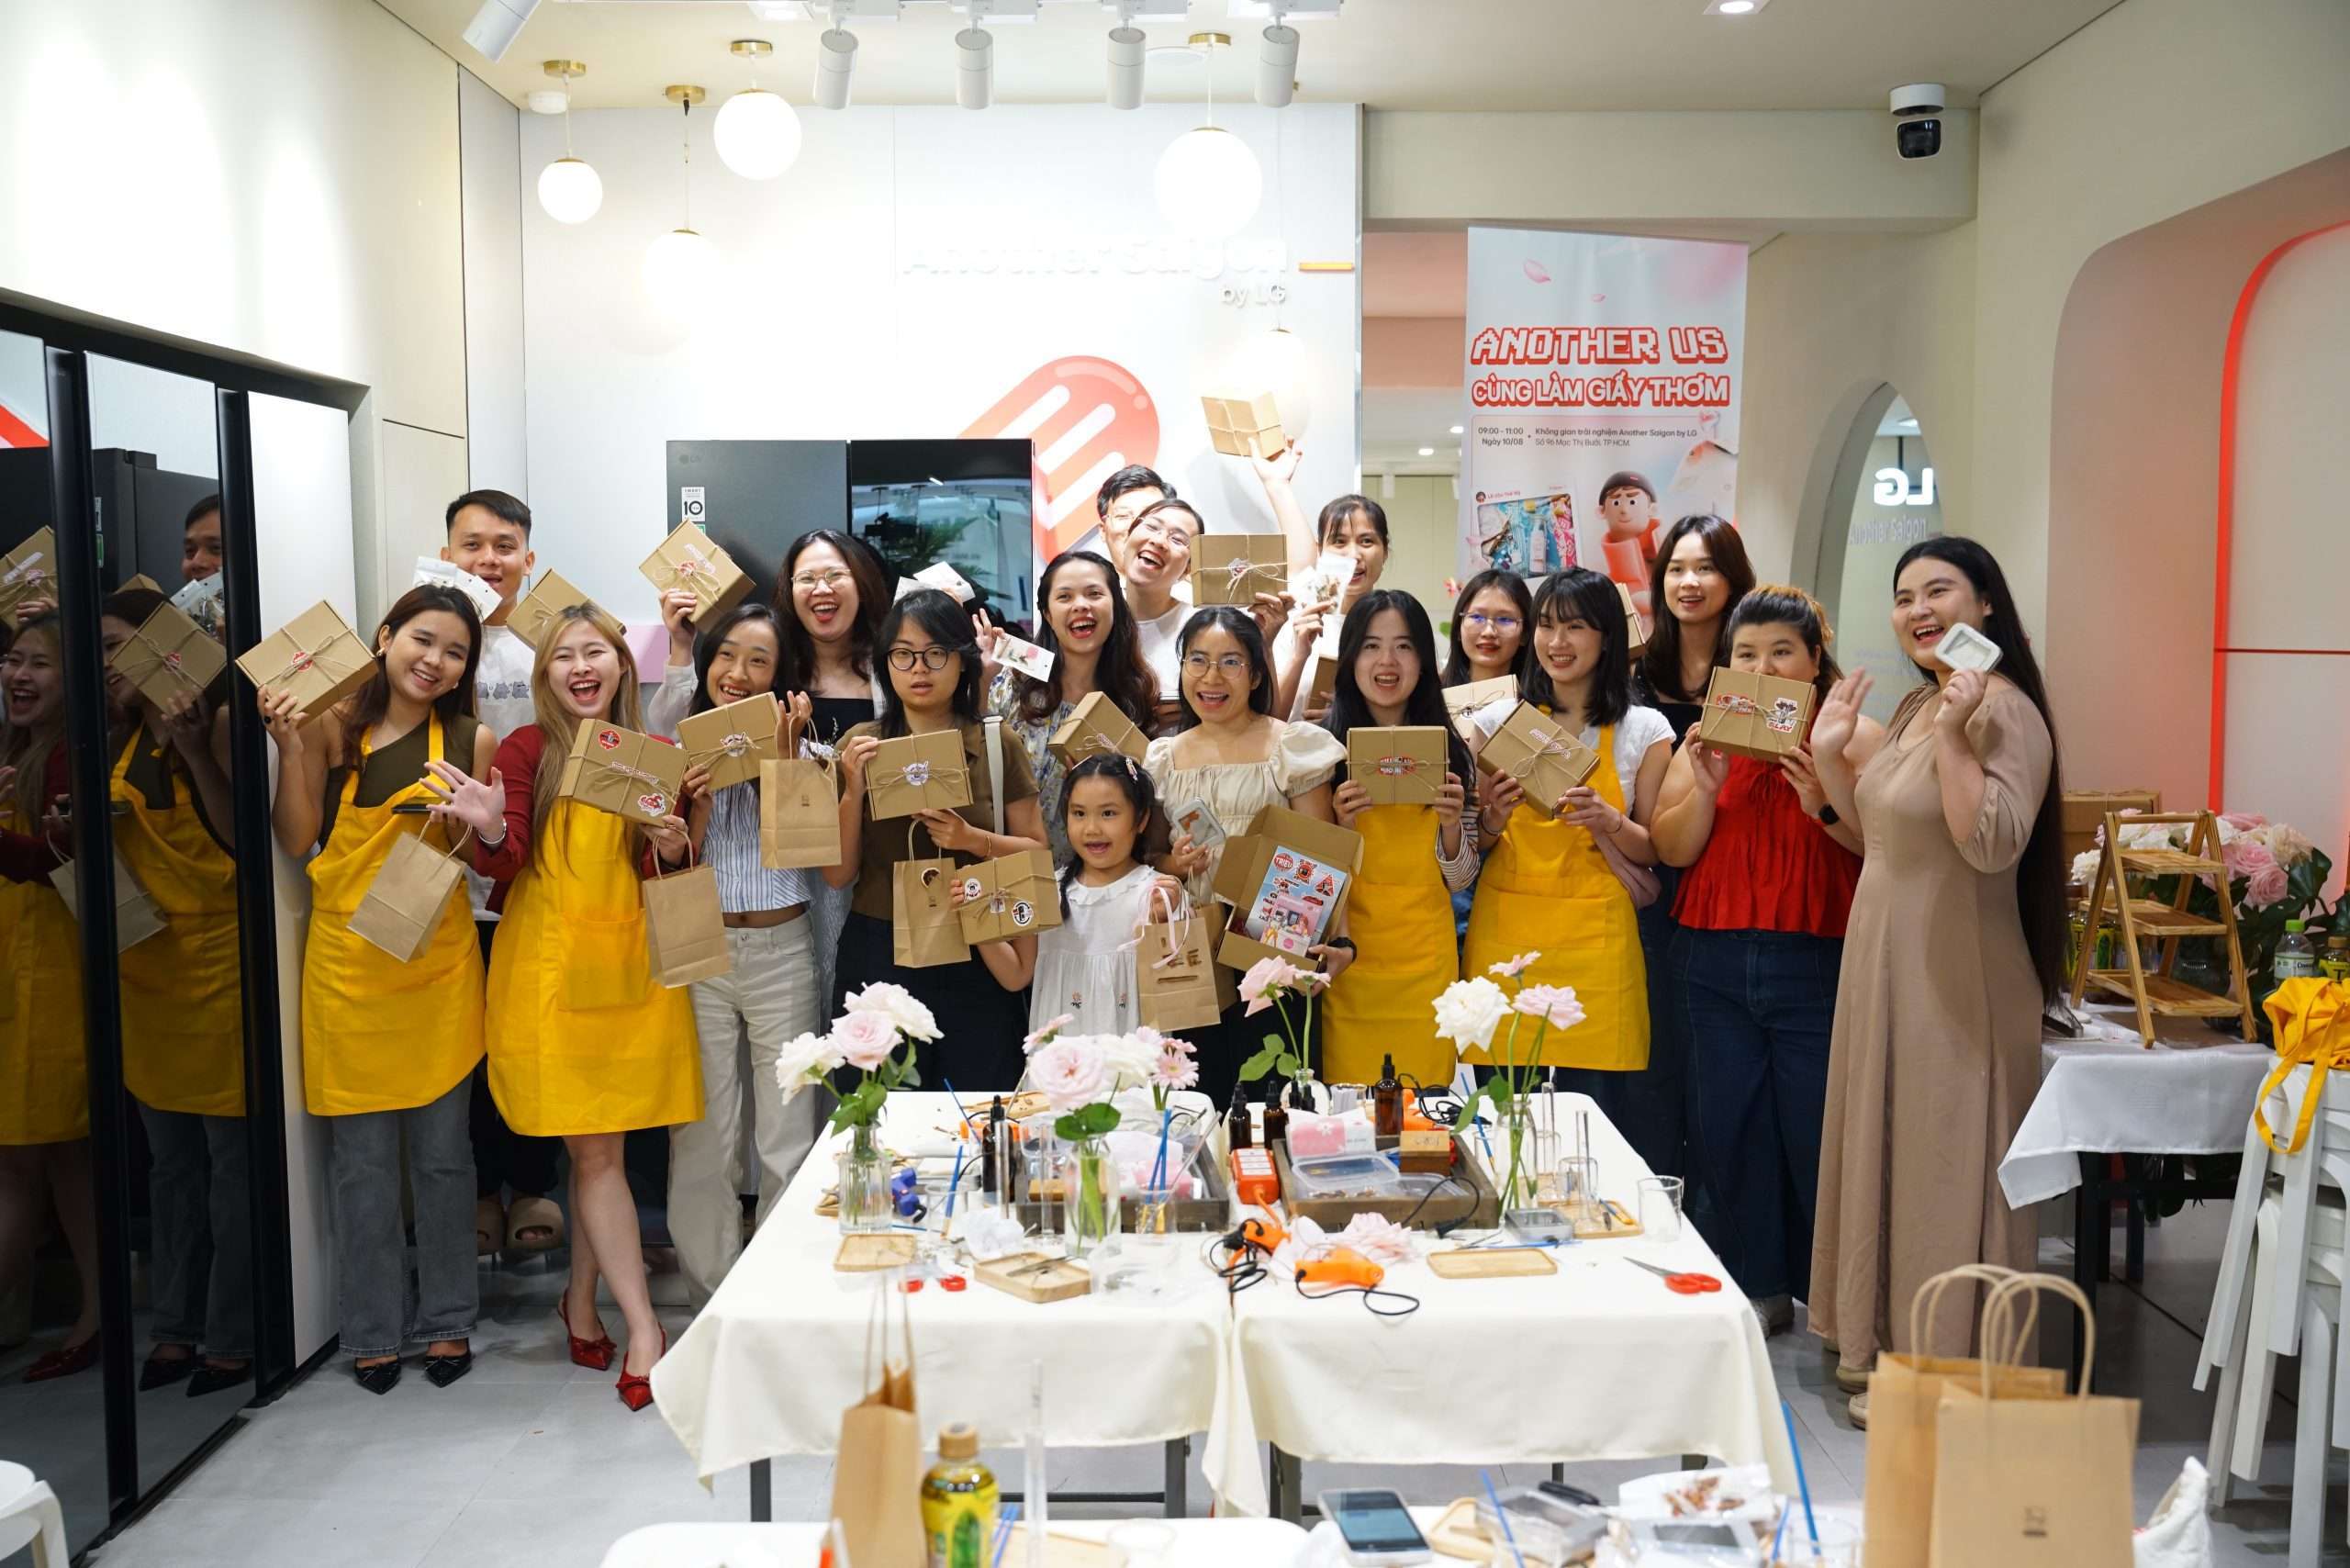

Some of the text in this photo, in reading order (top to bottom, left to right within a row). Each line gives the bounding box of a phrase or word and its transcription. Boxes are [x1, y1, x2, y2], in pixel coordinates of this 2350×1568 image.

[1220, 285, 1287, 308] by LG
[1470, 327, 1729, 364] ANOTHER US
[1472, 369, 1729, 407] CÙNG LÀM GIẤY THƠM
[1478, 427, 1499, 435] 09:00
[1505, 427, 1524, 435] 11:00
[1618, 429, 1647, 437] Another
[1650, 430, 1675, 439] Saigon
[1676, 430, 1685, 439] by
[1482, 438, 1501, 447] Ngày
